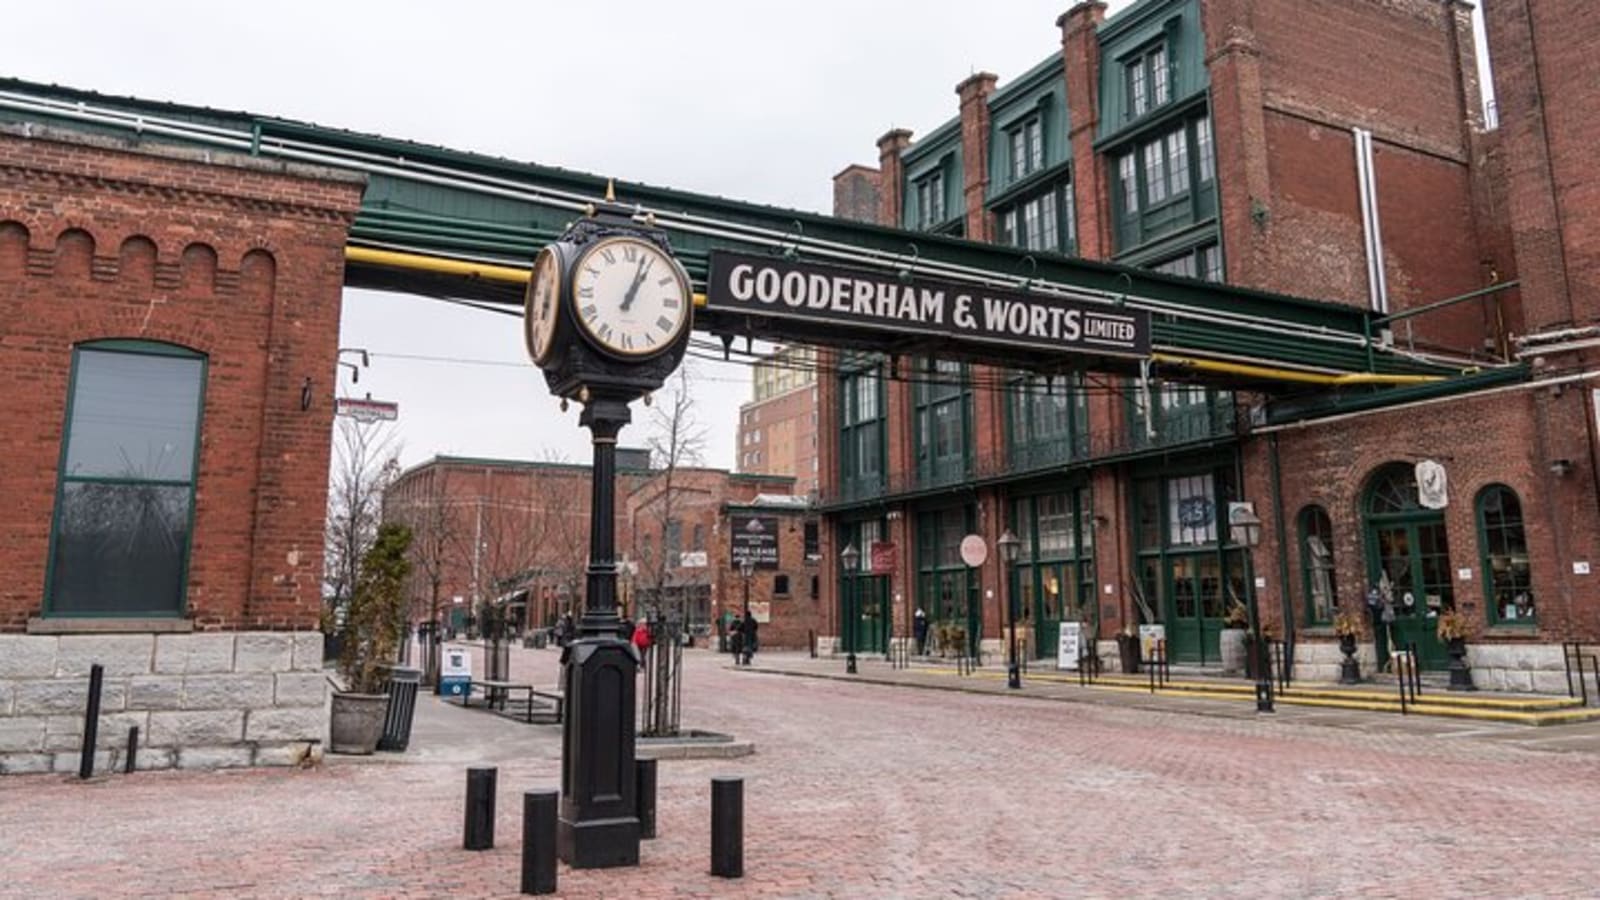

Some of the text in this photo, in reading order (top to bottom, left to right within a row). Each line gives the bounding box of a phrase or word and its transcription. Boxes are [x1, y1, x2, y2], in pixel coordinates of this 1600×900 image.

[729, 263, 1136, 342] GOODERHAM & WORTS LIMITED
